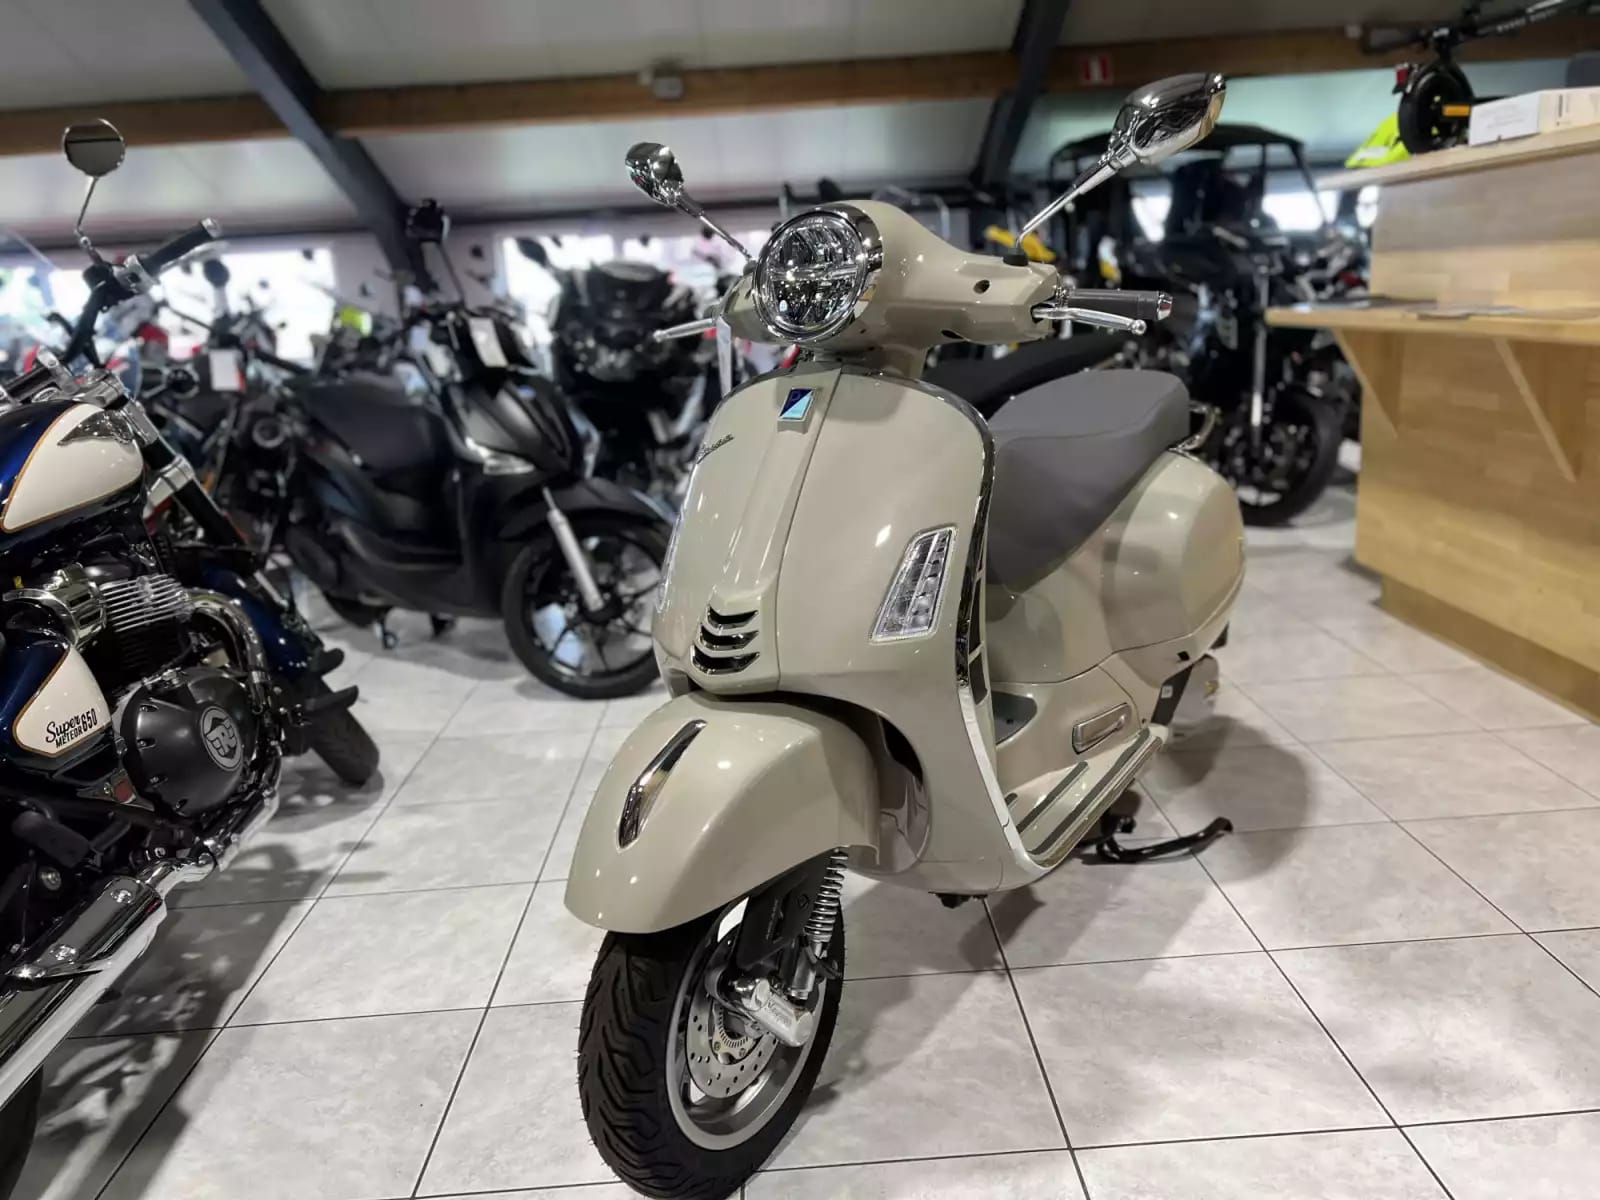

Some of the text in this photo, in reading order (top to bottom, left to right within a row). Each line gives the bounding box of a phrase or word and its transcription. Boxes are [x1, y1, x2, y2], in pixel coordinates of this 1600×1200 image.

[45, 715, 80, 743] Super
[55, 708, 98, 748] METEOR 650
